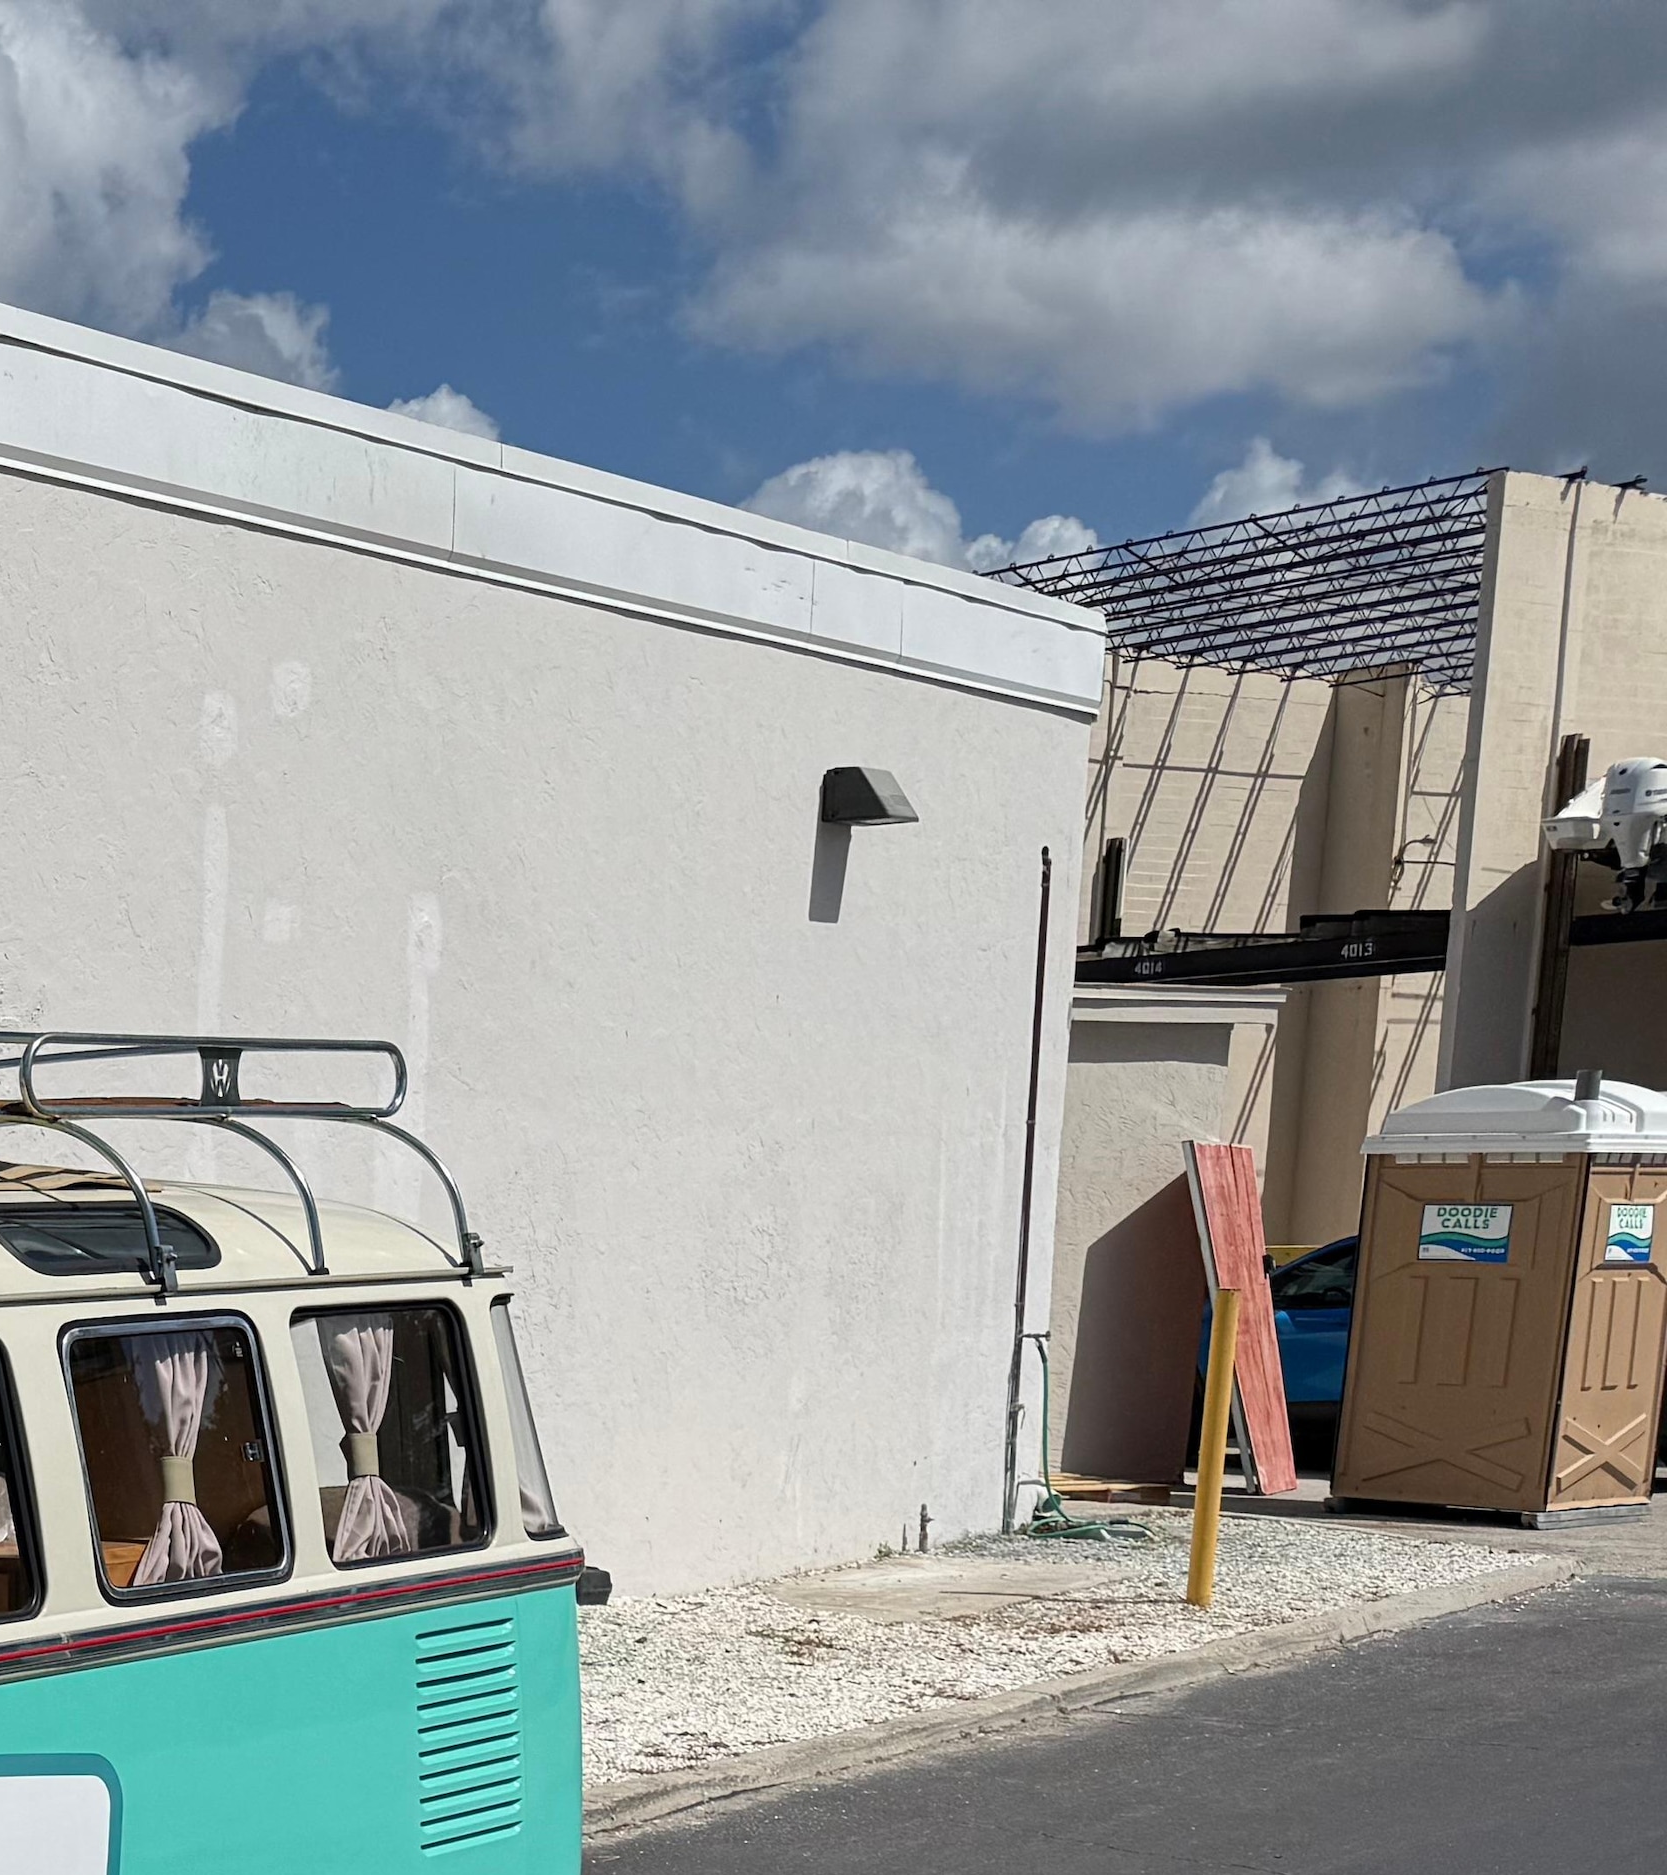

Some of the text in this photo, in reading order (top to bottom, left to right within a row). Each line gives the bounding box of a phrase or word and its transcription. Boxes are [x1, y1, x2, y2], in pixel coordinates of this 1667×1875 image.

[1340, 942, 1373, 959] 4013
[1134, 960, 1163, 975] 4014
[1437, 1207, 1498, 1218] DOODIE
[1441, 1218, 1490, 1229] CALLS
